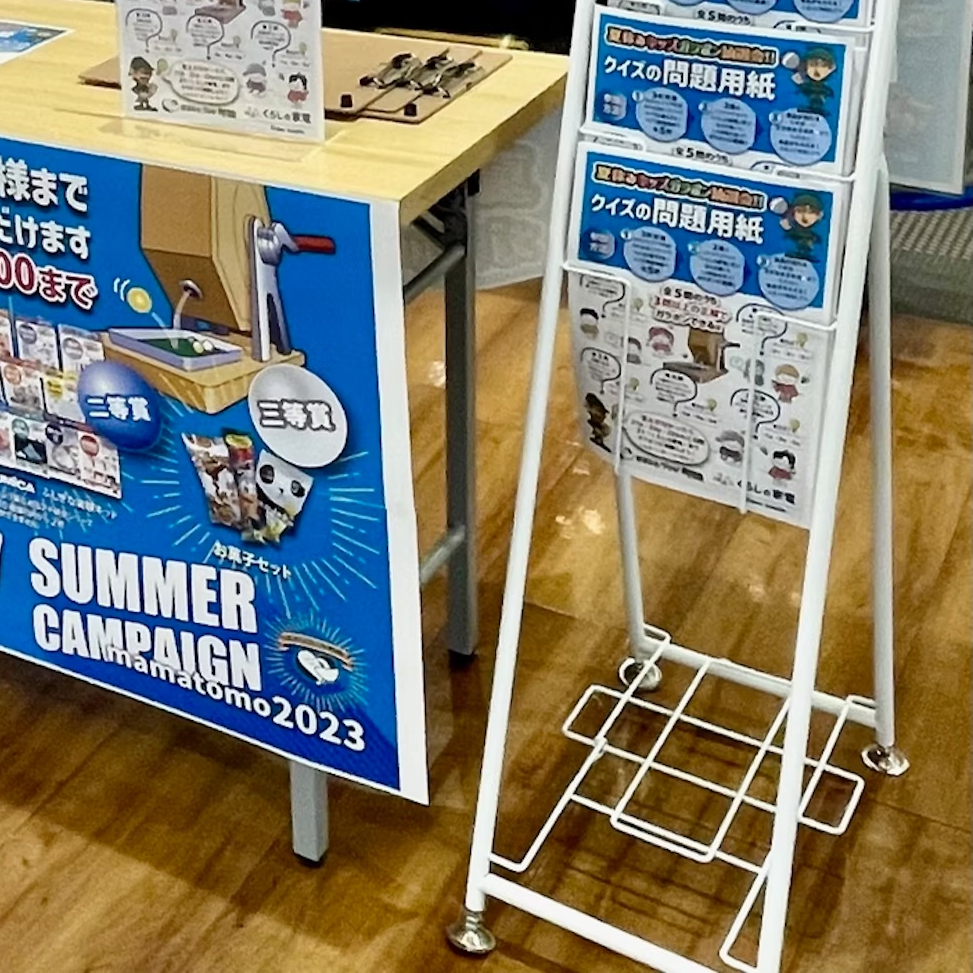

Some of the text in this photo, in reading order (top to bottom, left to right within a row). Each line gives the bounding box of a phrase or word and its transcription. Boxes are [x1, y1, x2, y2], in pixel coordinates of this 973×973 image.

[603, 56, 777, 101] クイズの問題用紙
[590, 193, 765, 245] クイズの問題用紙
[86, 393, 152, 423] 二等賞
[256, 398, 337, 433] 三等賞
[214, 539, 292, 579] お菓子セット
[28, 537, 258, 635] SUMMER
[32, 603, 262, 693] CAMPAIGN
[107, 644, 366, 753] mamatomo2023
